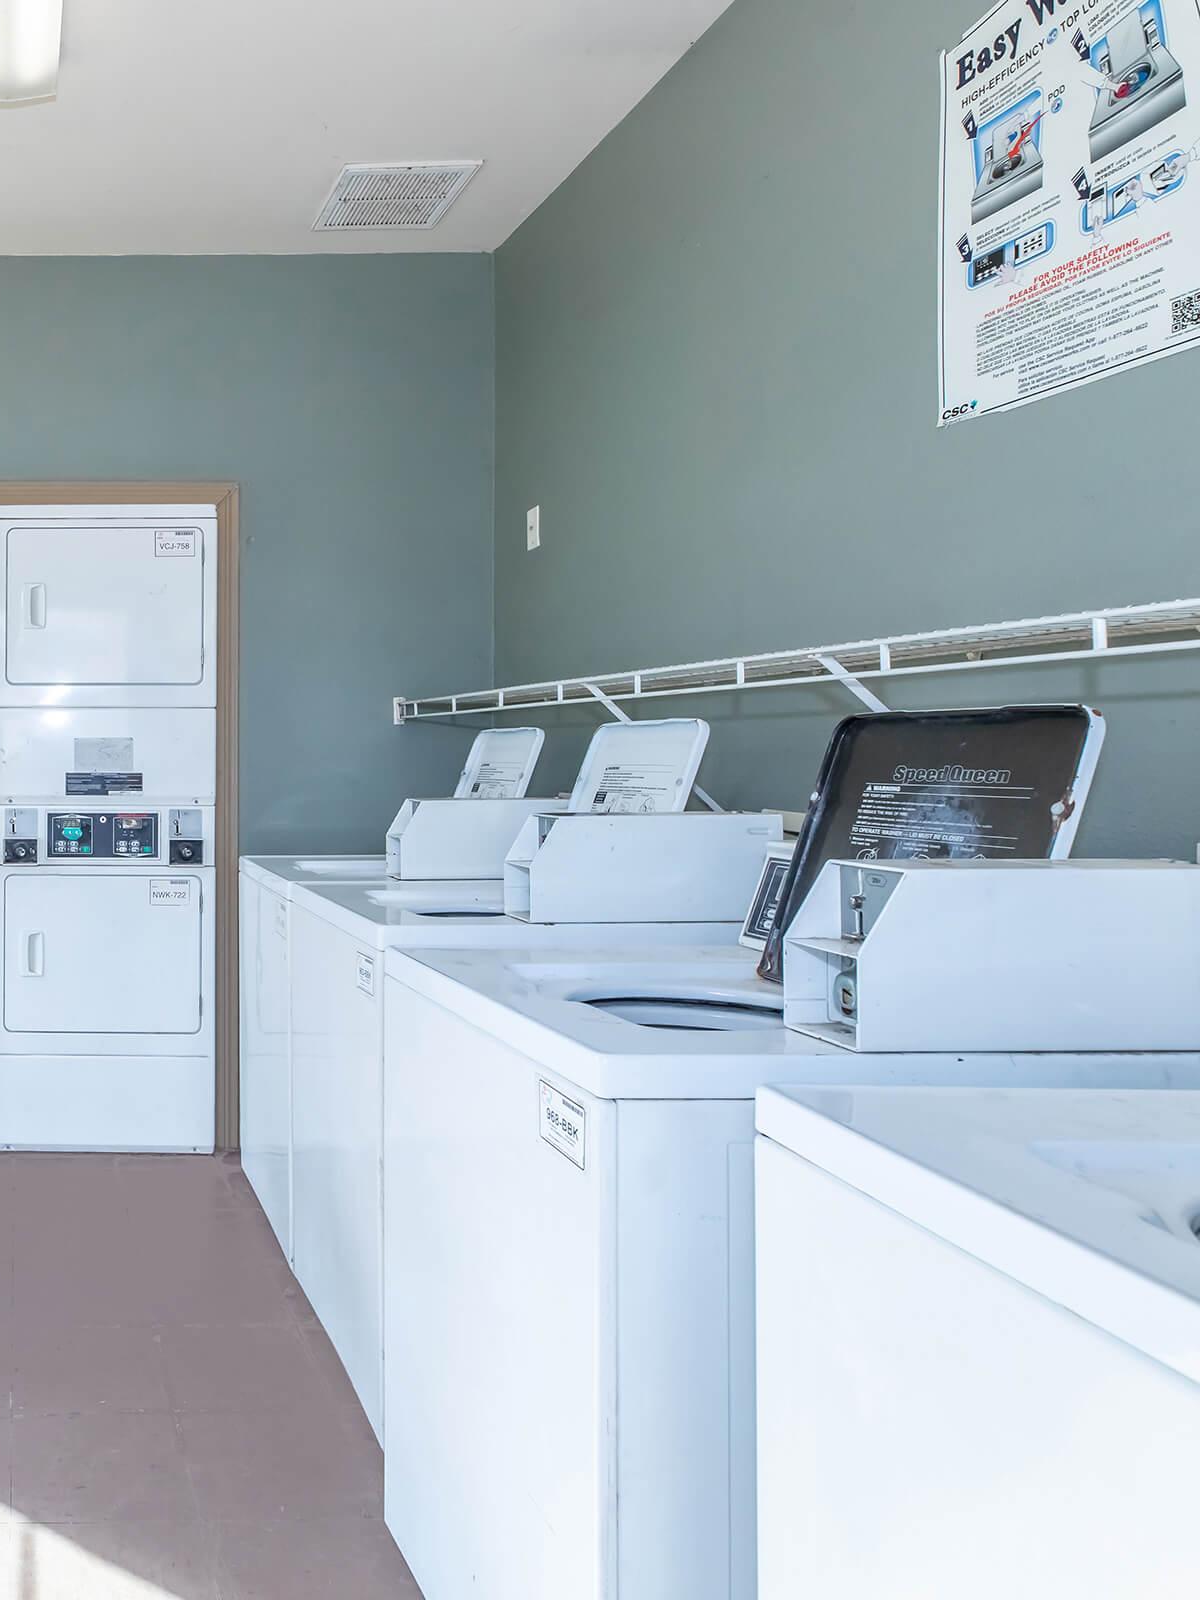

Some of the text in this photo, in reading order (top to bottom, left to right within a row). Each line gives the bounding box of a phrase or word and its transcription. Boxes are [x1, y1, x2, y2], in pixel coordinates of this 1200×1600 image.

[956, 18, 1022, 90] Easy
[961, 39, 1045, 108] HIGH-EFFICIENCY
[1060, 9, 1080, 32] TOP
[1048, 85, 1066, 102] POD
[961, 244, 969, 255] 3
[1034, 244, 1108, 284] FOR YOUR SAFETY
[1079, 262, 1100, 277] FAVOR
[1102, 253, 1120, 267] EVITE
[1133, 231, 1170, 253] SIGUIENTE
[1008, 237, 1138, 302] PLEASE AVOID THE FOLLOWING
[942, 404, 968, 420] CSC
[160, 542, 190, 550] VCJ-758
[893, 764, 1011, 784] Speed Queen
